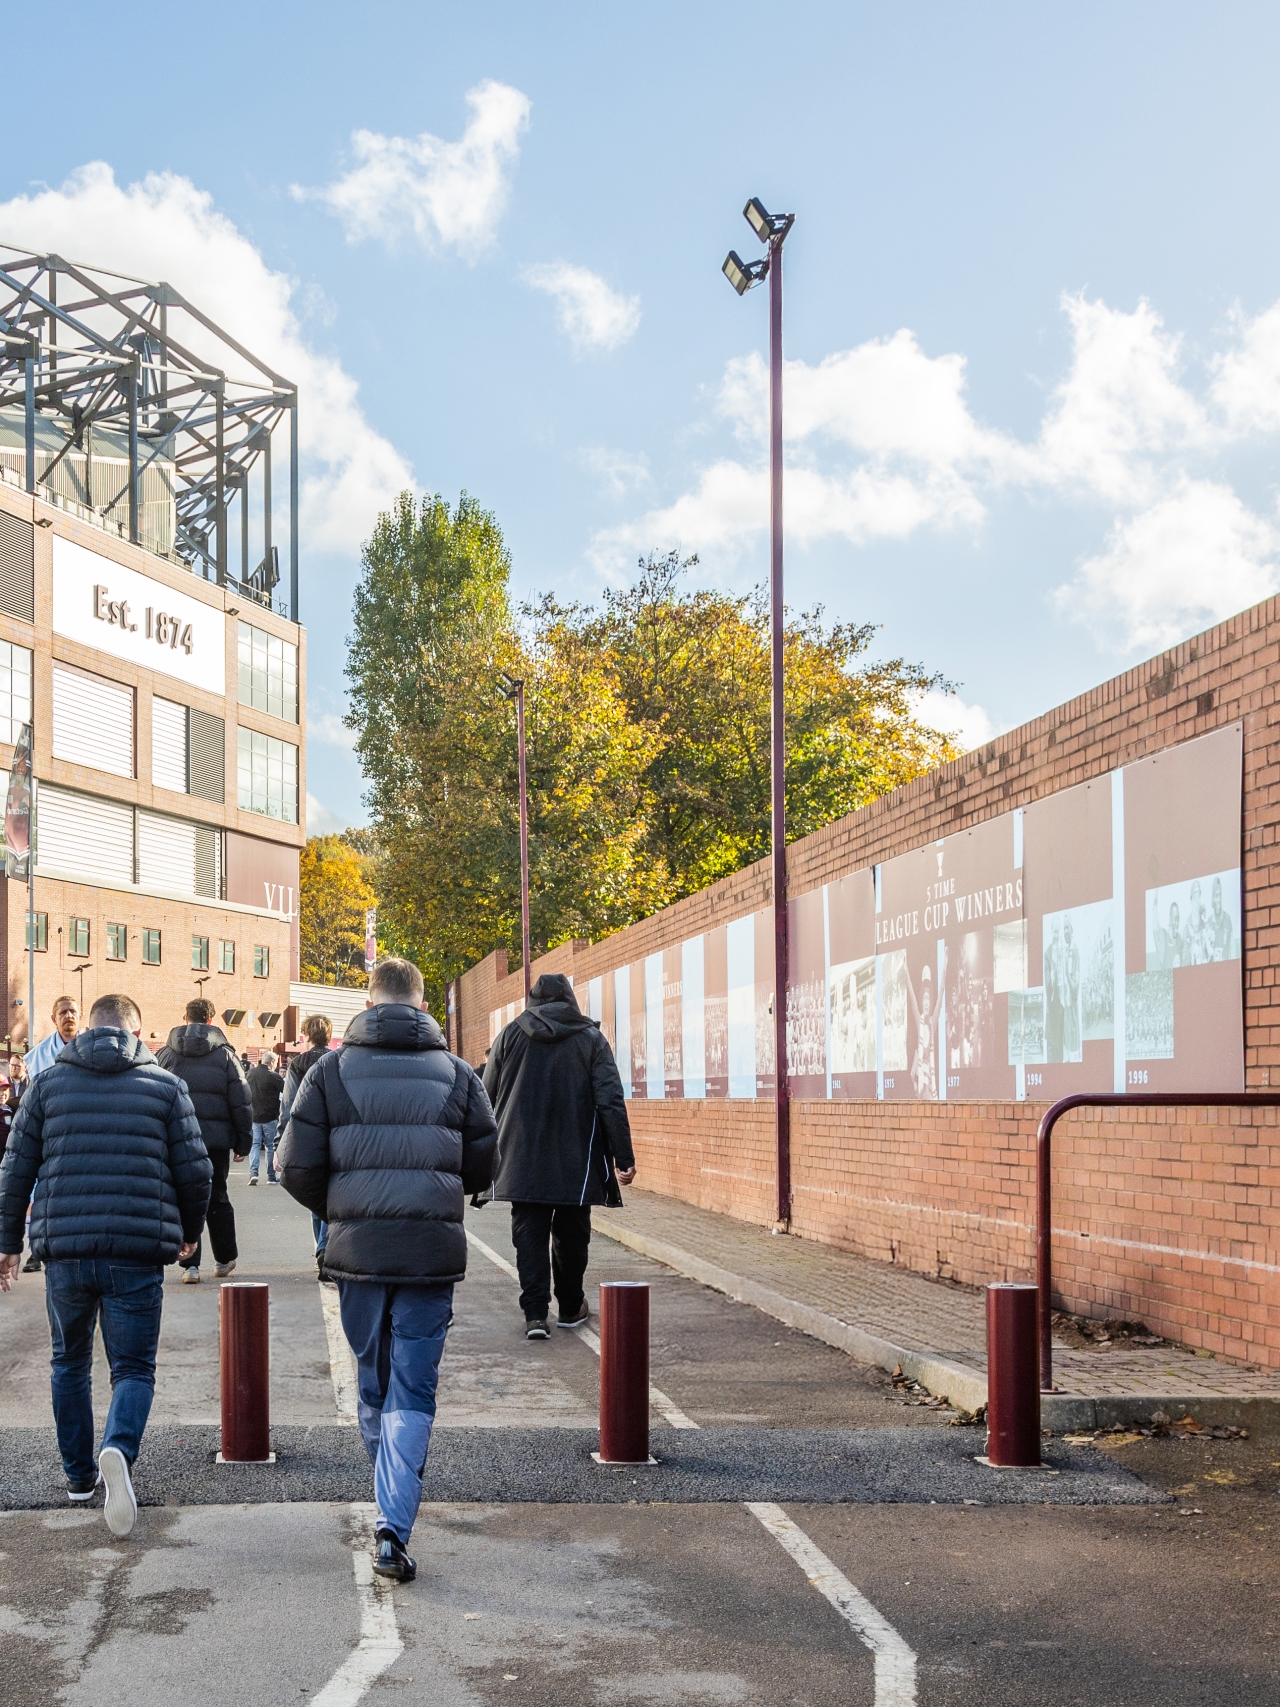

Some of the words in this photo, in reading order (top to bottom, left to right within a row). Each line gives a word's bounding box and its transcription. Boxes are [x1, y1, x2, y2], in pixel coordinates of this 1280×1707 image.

[93, 584, 138, 632] Est.
[145, 606, 193, 655] 1874
[926, 886, 931, 903] 5
[934, 878, 956, 900] TIME
[876, 910, 919, 945] LEAGUE
[924, 902, 950, 932] CUP
[954, 878, 1023, 923] WINNERS
[884, 1078, 895, 1088] 1975
[947, 1076, 960, 1087] 1977
[1027, 1073, 1043, 1086] 1994
[1128, 1070, 1148, 1084] 1996
